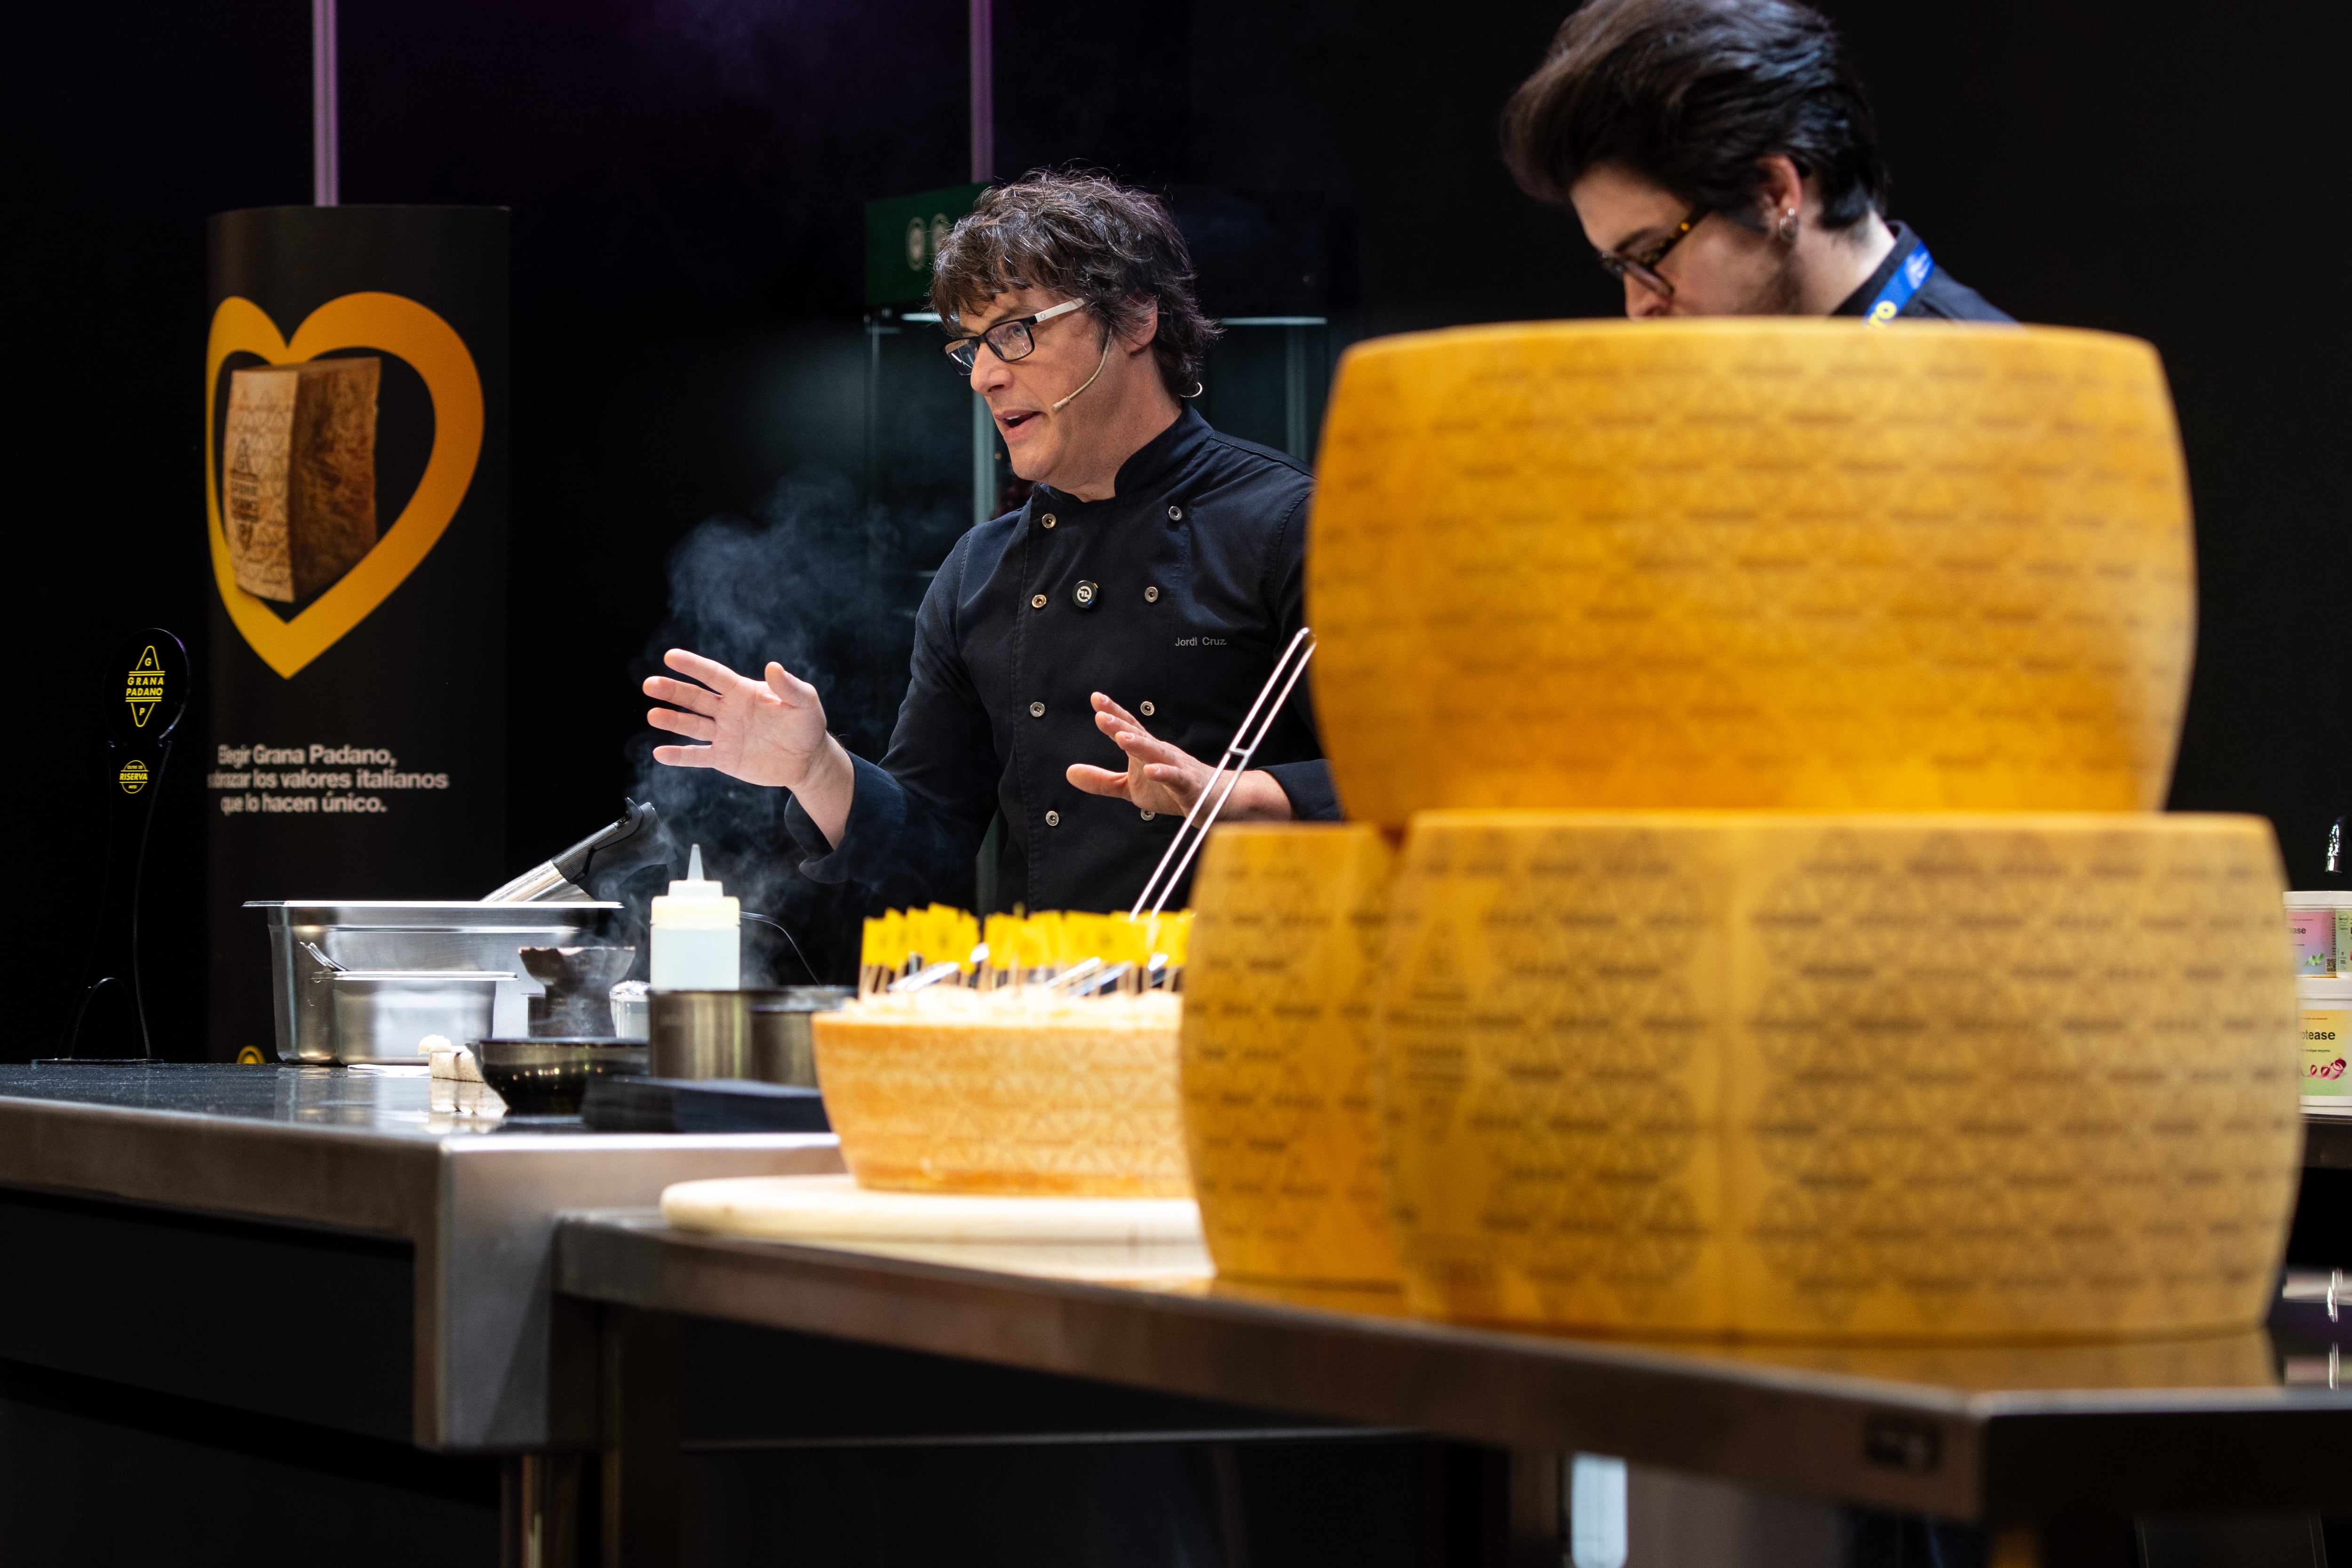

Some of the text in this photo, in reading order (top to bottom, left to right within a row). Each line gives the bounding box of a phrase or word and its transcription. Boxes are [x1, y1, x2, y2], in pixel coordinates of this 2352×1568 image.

[1175, 637, 1227, 647] Jordi Cruz
[144, 658, 152, 666] G
[127, 677, 164, 685] GRANA
[126, 688, 163, 696] PADANO
[139, 708, 145, 716] P
[253, 744, 306, 765] Grana
[310, 744, 397, 768] Padano,
[253, 768, 278, 789] los
[280, 768, 353, 789] valores
[356, 768, 450, 789] italianos
[221, 791, 388, 817] que lo hacen único.
